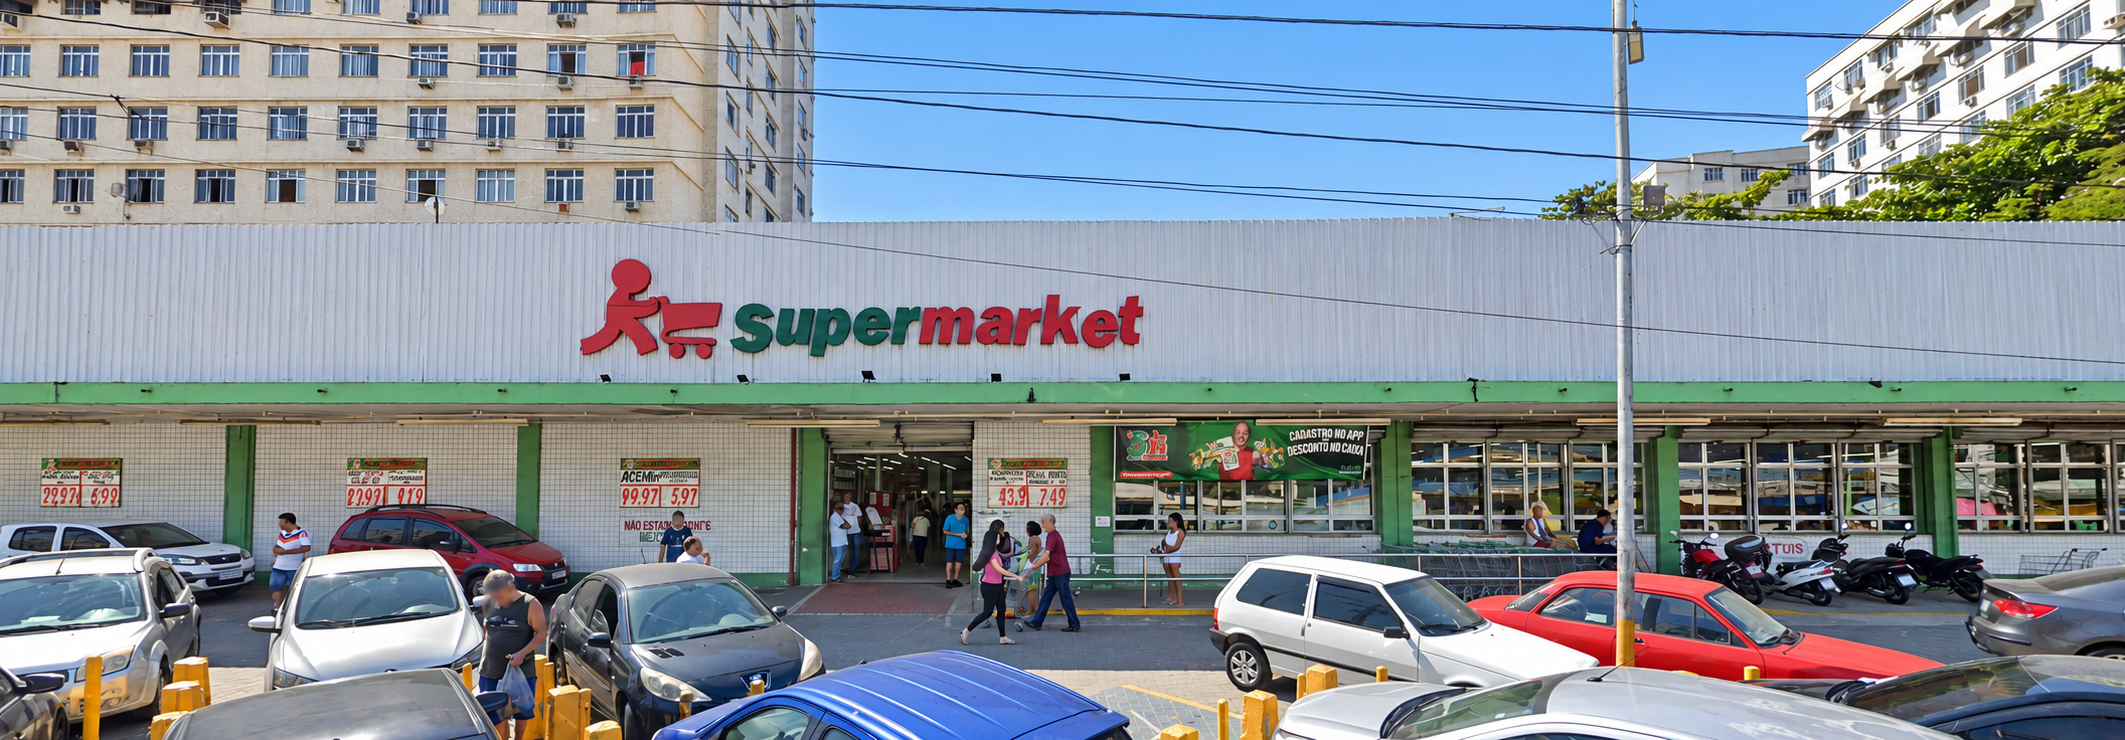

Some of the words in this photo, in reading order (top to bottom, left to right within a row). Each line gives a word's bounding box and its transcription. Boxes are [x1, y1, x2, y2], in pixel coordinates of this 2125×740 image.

[1334, 428, 1346, 439] NO
[1346, 430, 1364, 441] APP
[1287, 441, 1329, 457] DESCONTO
[1329, 441, 1341, 452] NO
